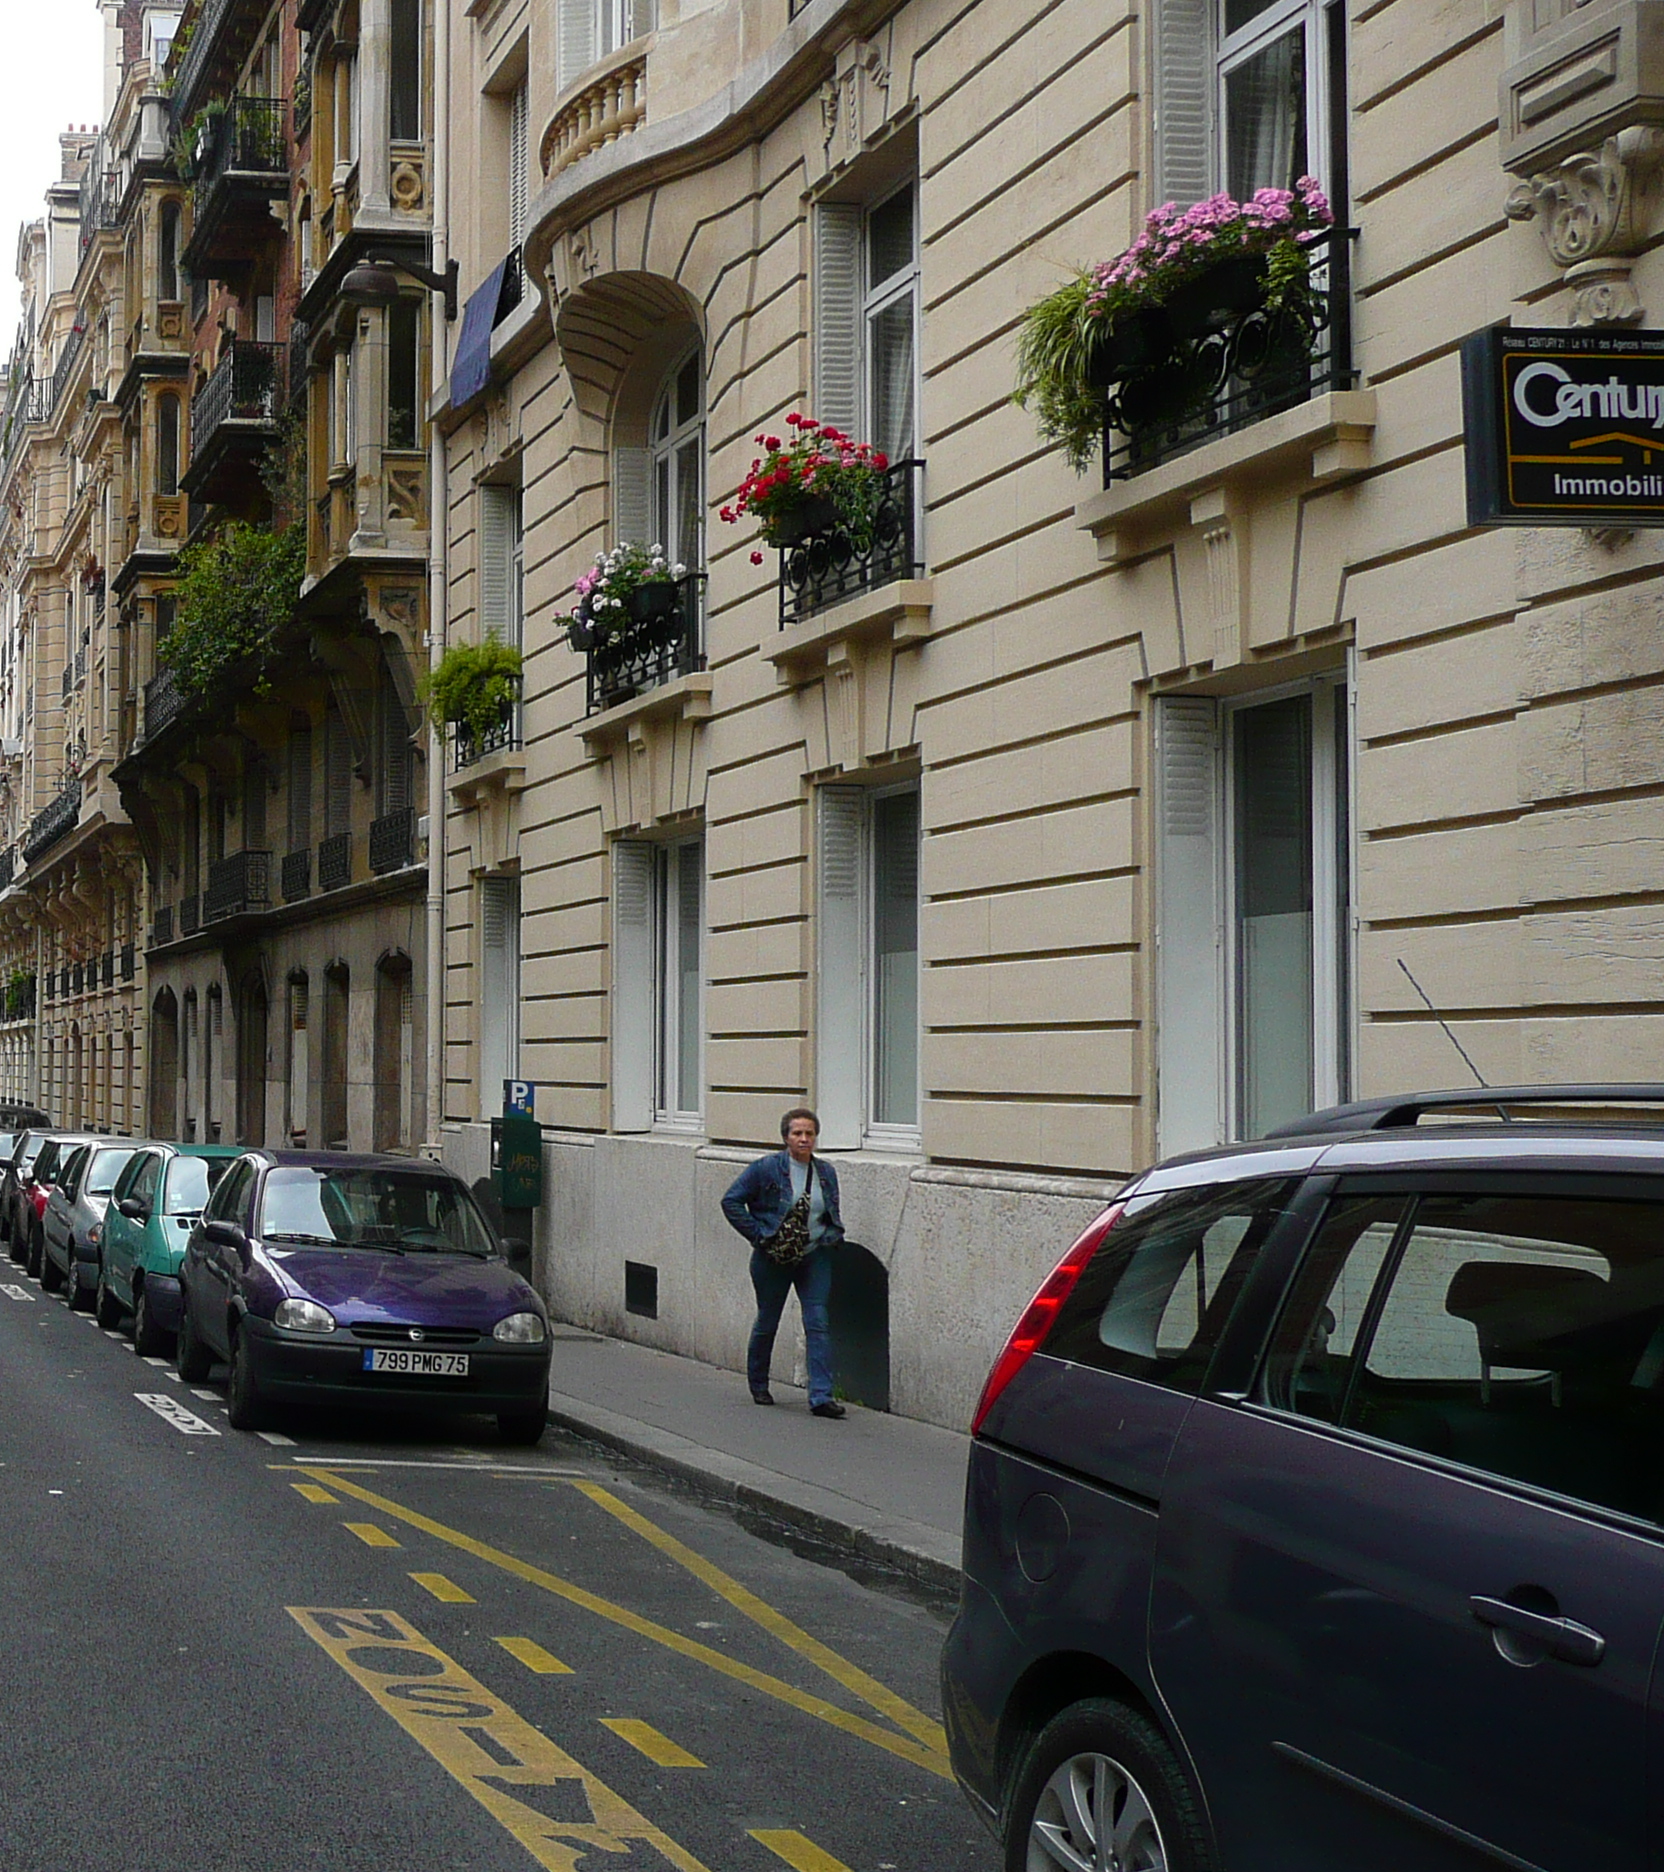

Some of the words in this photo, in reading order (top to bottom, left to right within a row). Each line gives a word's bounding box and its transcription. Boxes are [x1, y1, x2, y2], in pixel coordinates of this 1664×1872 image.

[1528, 337, 1557, 348] CENTURY
[1613, 338, 1639, 352] Agences
[1554, 473, 1663, 496] Immobili
[511, 1082, 529, 1104] P
[377, 1351, 408, 1371] 799
[411, 1353, 442, 1373] PMG
[445, 1355, 466, 1374] 75
